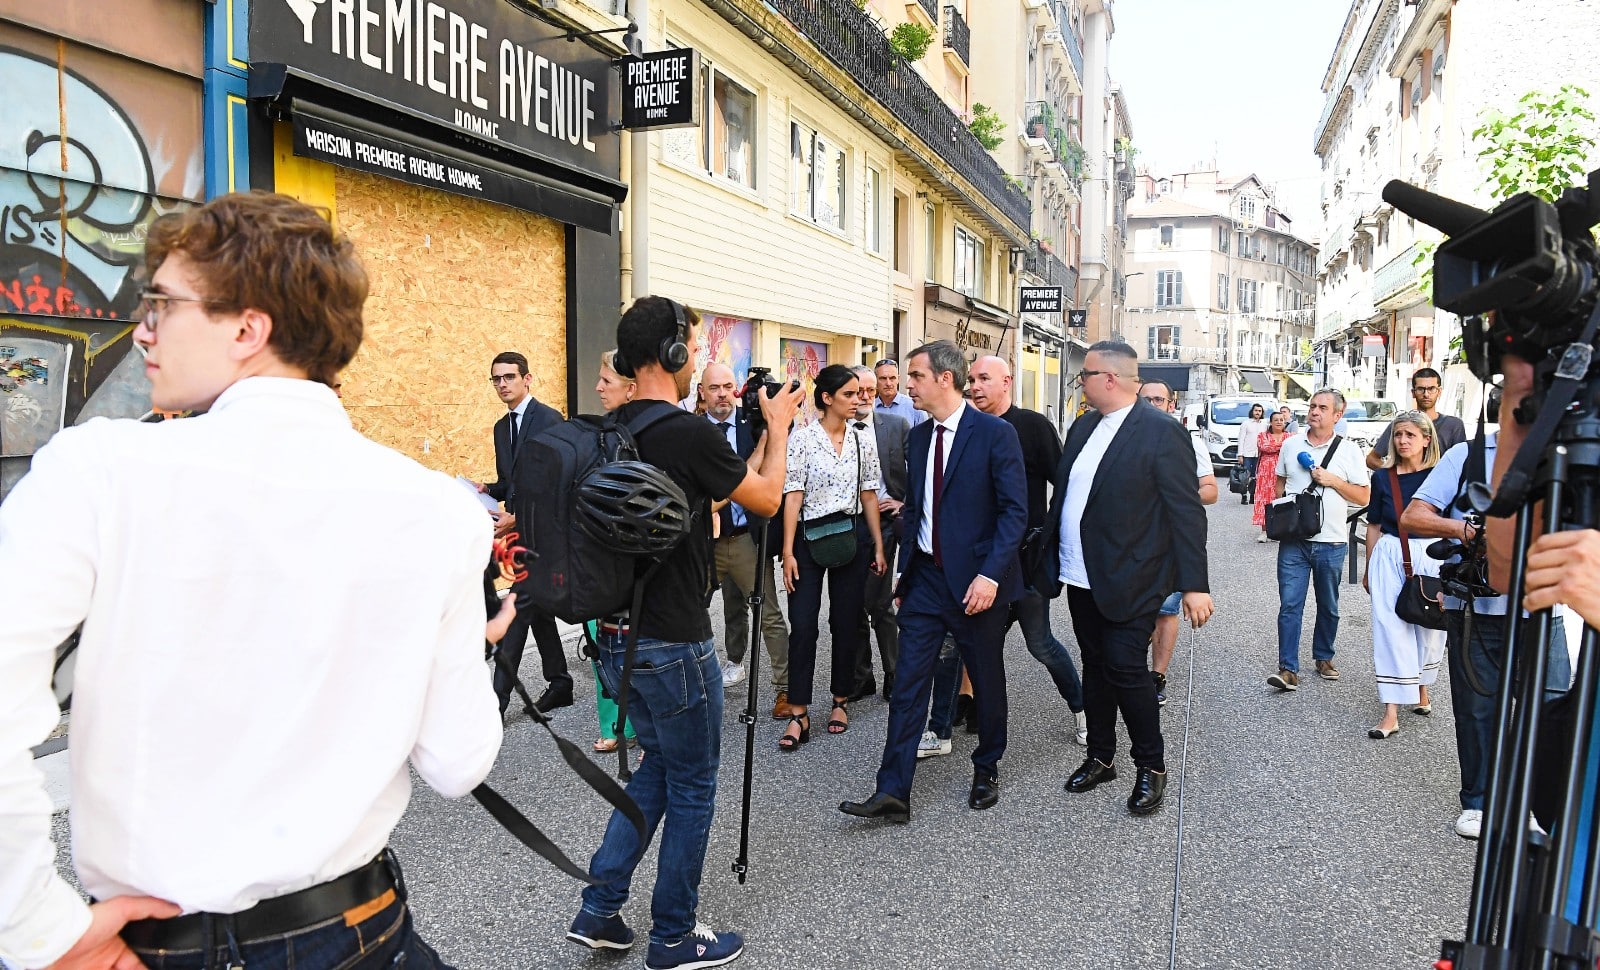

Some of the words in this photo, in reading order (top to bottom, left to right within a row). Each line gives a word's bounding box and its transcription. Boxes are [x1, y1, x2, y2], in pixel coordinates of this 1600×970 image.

[628, 56, 687, 86] PREMIERE
[499, 38, 596, 153] AVENUE
[634, 81, 680, 109] AVENUE
[454, 108, 499, 140] HOMME
[646, 107, 669, 119] HOMME
[305, 127, 352, 159] MAISON
[355, 141, 407, 173] PREMIERE
[409, 156, 446, 183] AVENUE
[447, 167, 483, 192] HOMME
[1022, 289, 1059, 299] PREMIERE
[1024, 300, 1058, 310] AVENUE
